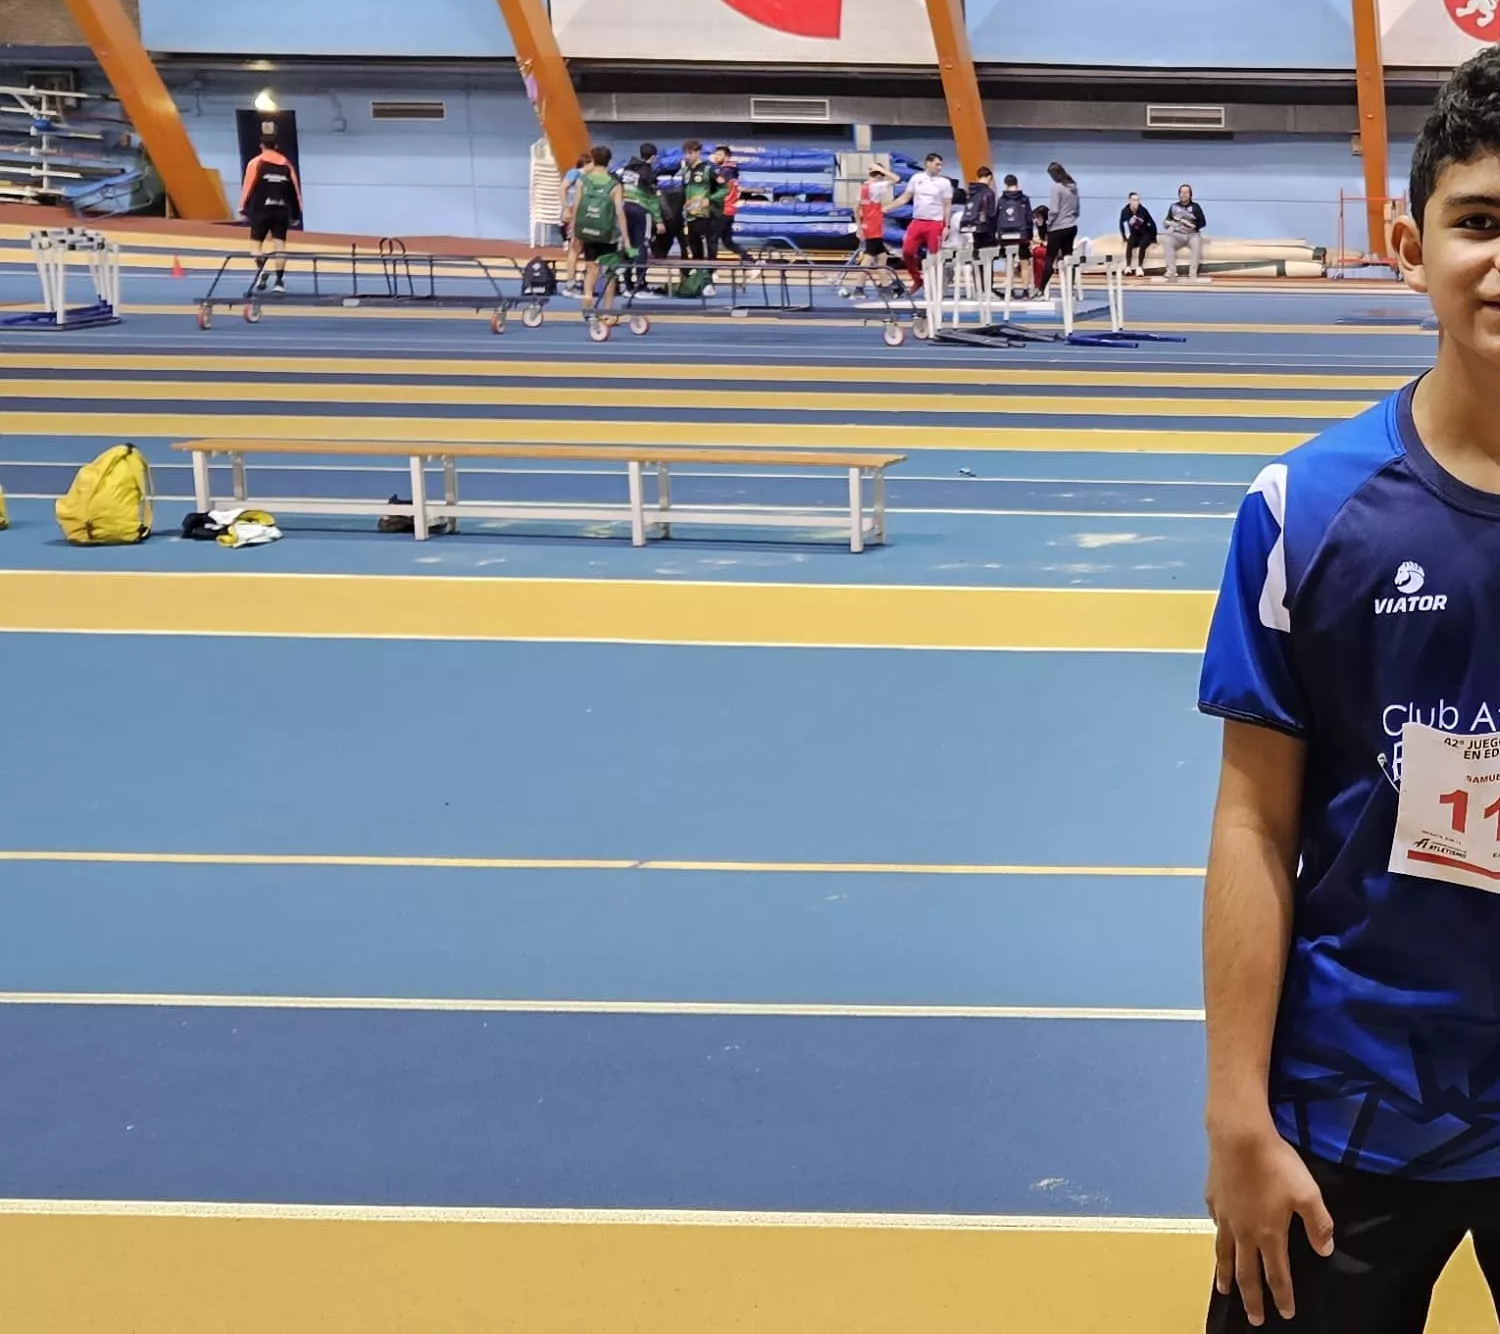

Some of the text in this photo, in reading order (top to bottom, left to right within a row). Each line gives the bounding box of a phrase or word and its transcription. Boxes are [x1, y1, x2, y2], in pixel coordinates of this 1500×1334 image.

[1374, 595, 1447, 615] VIATOR
[1382, 699, 1459, 737] Club
[1463, 750, 1481, 760] EN
